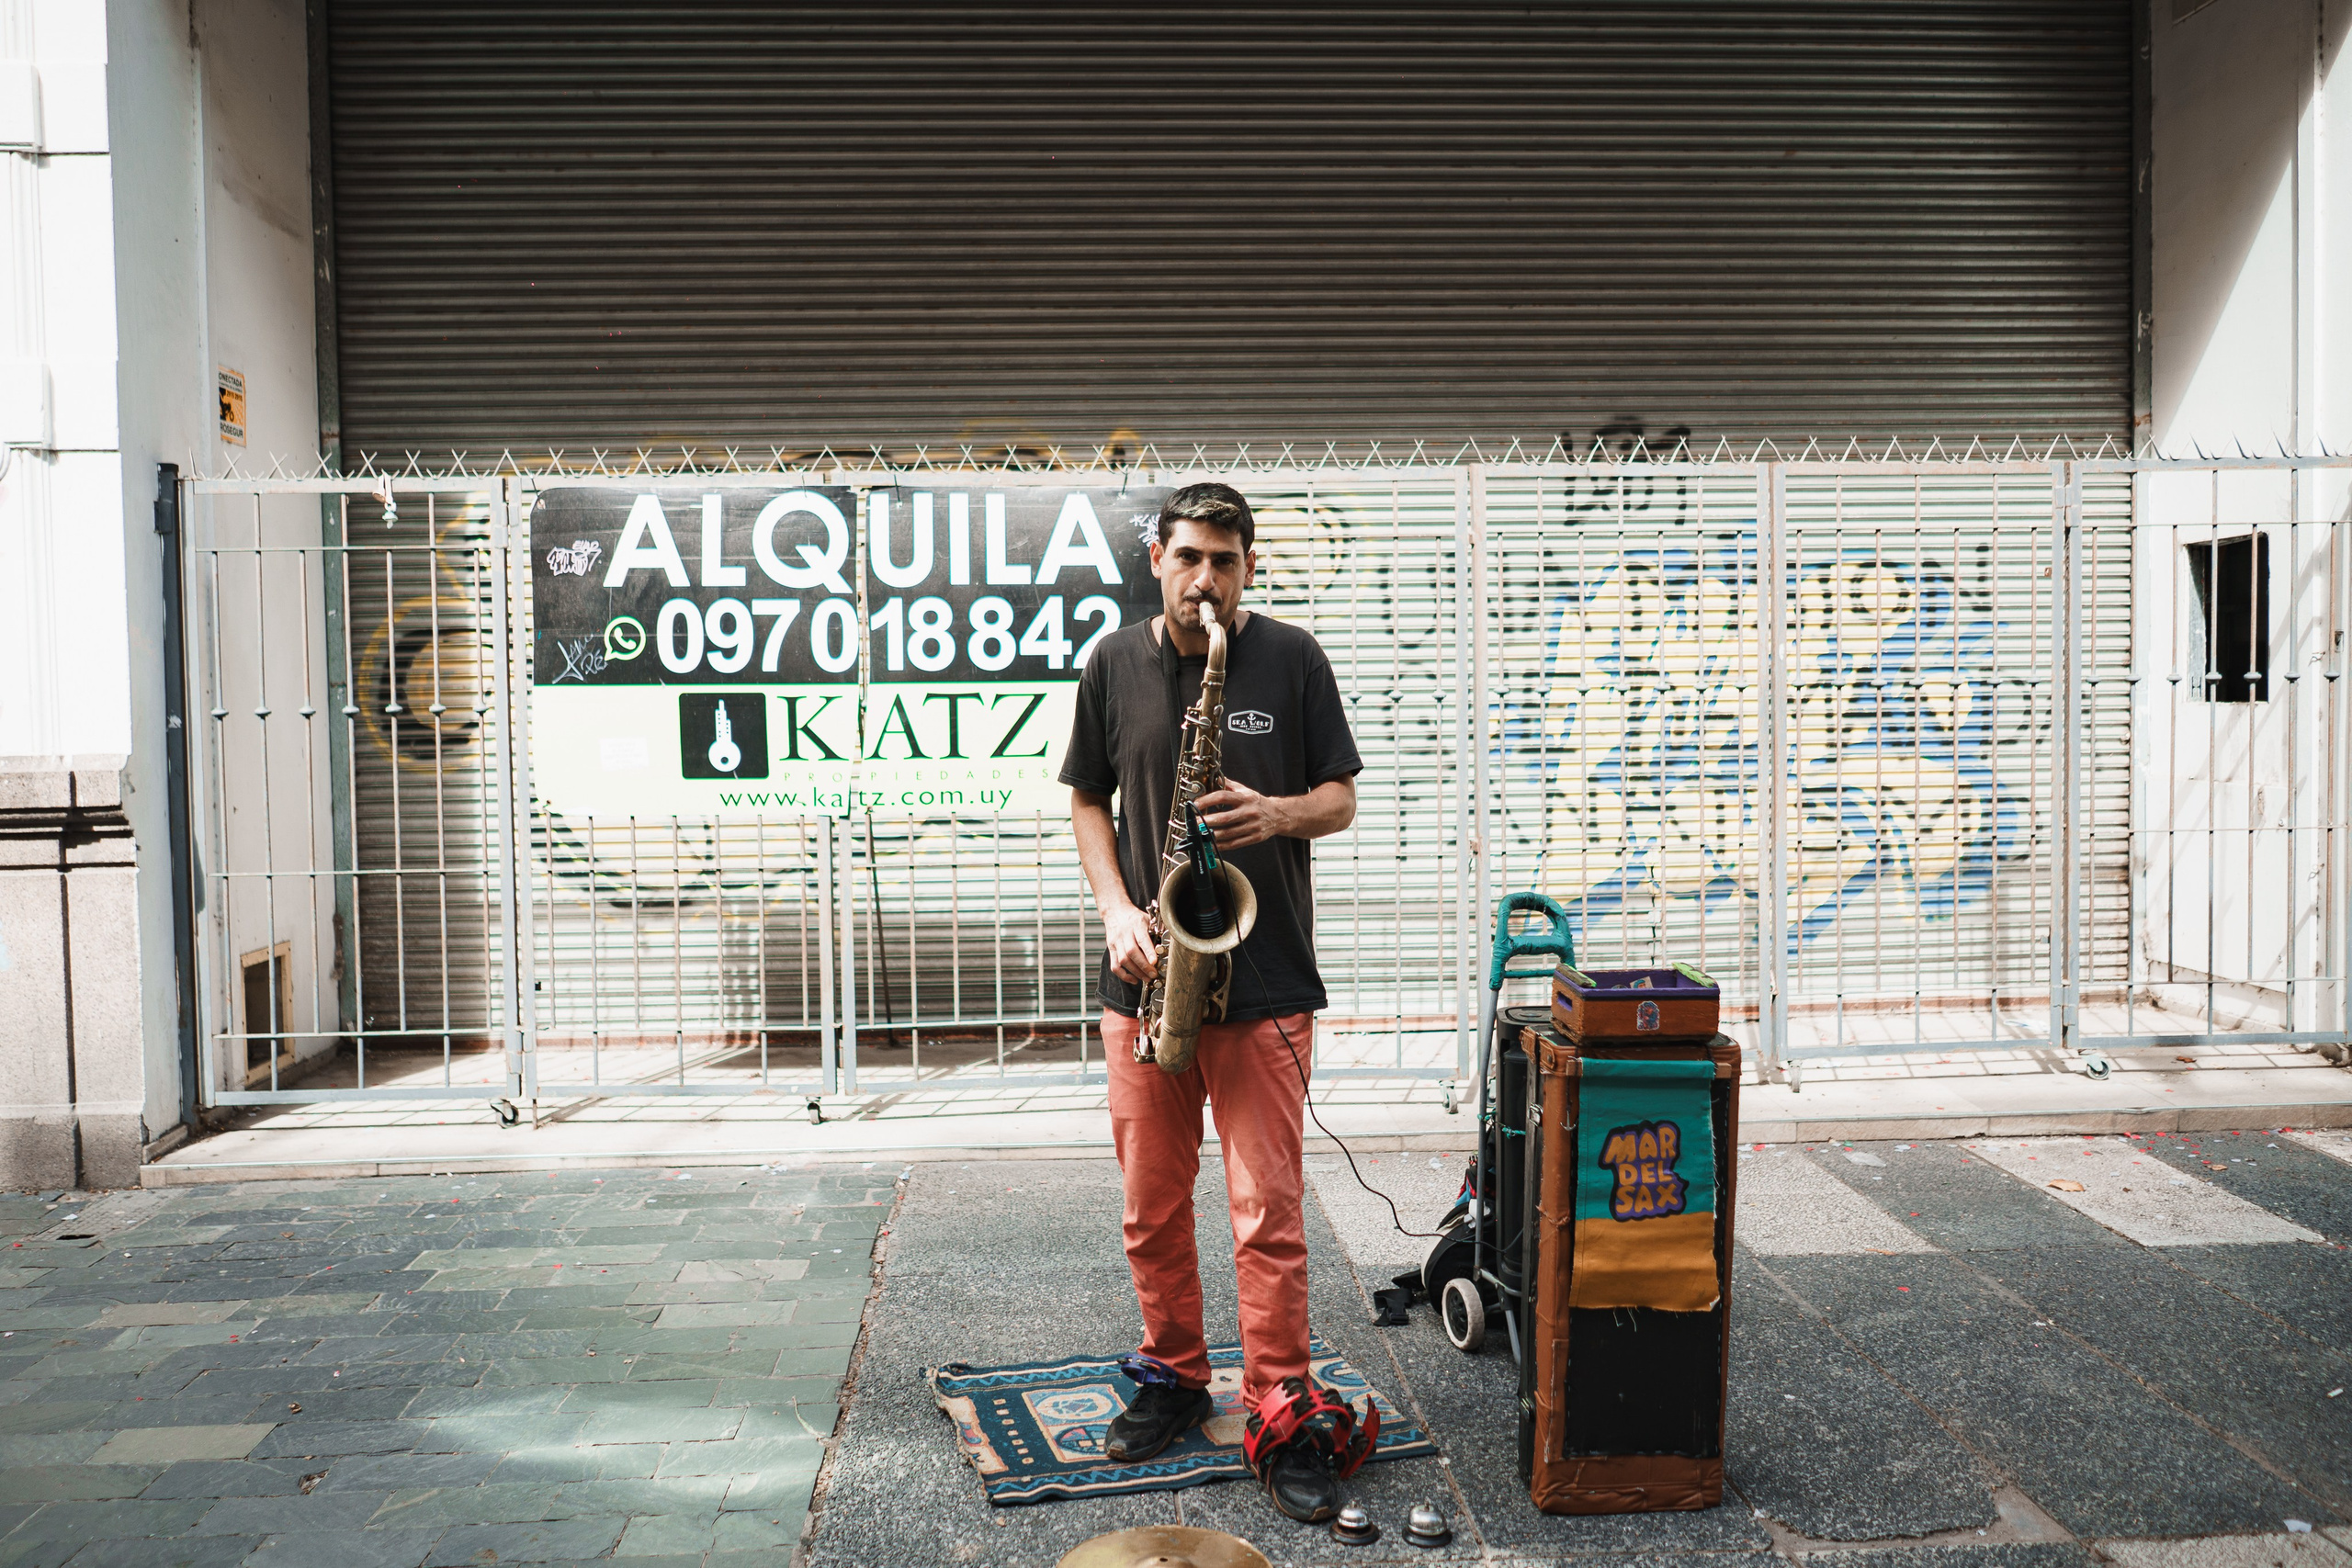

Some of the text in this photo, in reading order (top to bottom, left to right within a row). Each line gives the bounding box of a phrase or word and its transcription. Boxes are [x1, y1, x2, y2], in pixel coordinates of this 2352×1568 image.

[220, 423, 243, 438] ROSEGUR
[603, 491, 1123, 593] ALQUILA
[778, 693, 1048, 761] KATZ
[785, 769, 1048, 783] PROPIEDADES
[719, 786, 1013, 810] www.katz.com.uy
[1604, 1126, 1677, 1164] MAR
[1618, 1160, 1674, 1185] DEL
[1615, 1184, 1679, 1213] SAX
